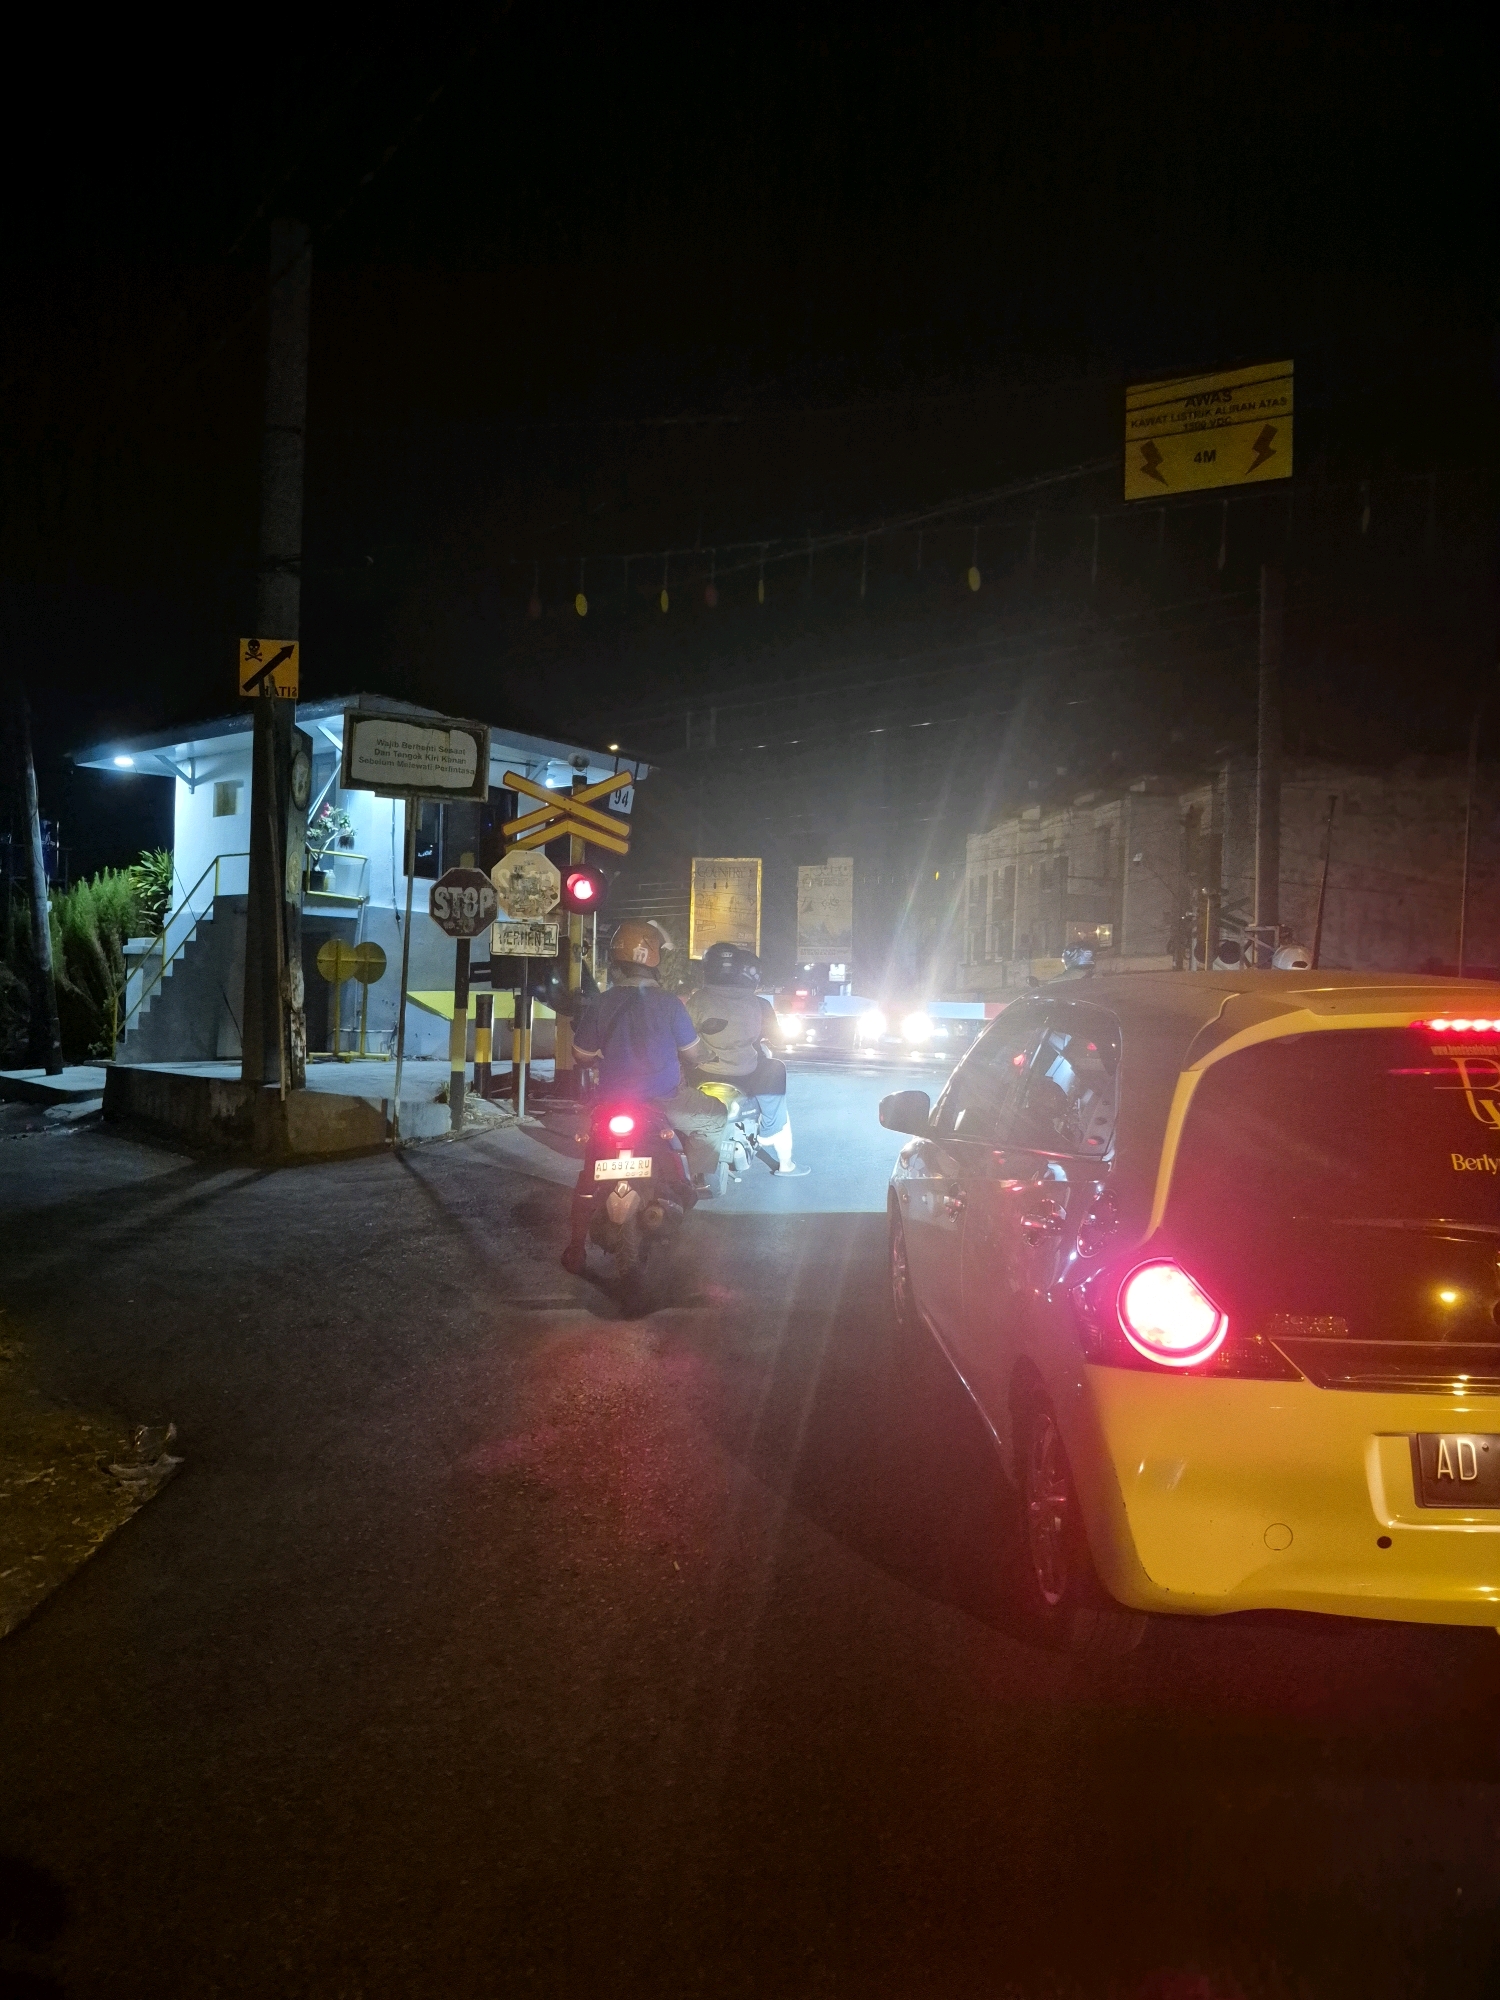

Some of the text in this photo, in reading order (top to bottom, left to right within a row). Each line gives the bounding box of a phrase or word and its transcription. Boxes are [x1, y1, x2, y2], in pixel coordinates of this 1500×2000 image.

[1184, 390, 1232, 408] AWAS
[1131, 397, 1287, 428] KAWAT LISTRIK ALIRAN ATAS
[1193, 449, 1217, 463] 4M
[377, 739, 466, 755] Wajib Berhenti Sesaat
[358, 756, 395, 767] Sebelum
[397, 760, 433, 771] Melewati
[374, 748, 467, 765] Dan Tengok Kiri Kanan
[434, 886, 494, 920] STOP
[596, 1162, 608, 1172] AD
[1451, 1153, 1500, 1175] Berly
[1437, 1438, 1478, 1481] AD
